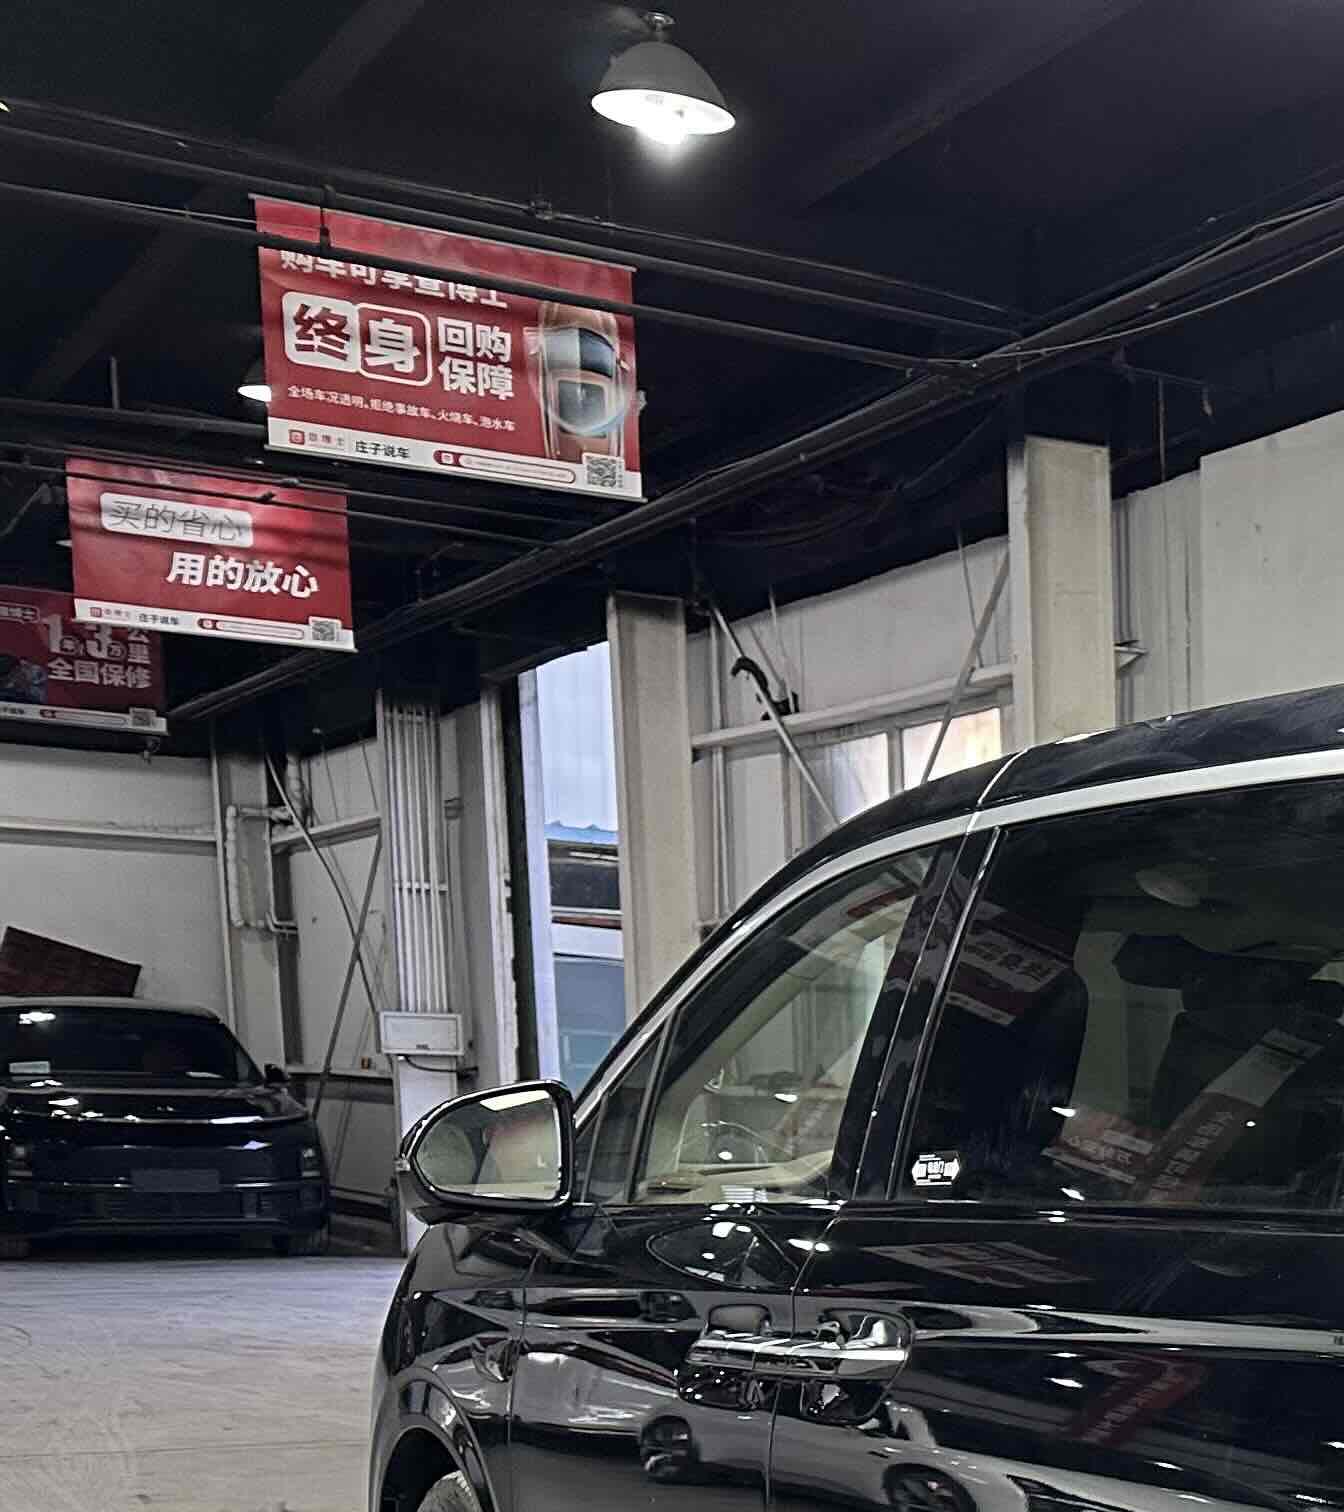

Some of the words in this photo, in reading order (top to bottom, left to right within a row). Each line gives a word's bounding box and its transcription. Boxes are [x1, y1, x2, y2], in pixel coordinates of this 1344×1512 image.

[293, 304, 421, 374] 终身
[437, 317, 512, 363] 回购
[438, 356, 514, 401] 保障
[110, 500, 242, 542] 买的省心
[166, 551, 320, 599] 用的放心
[48, 656, 152, 690] 全国保修
